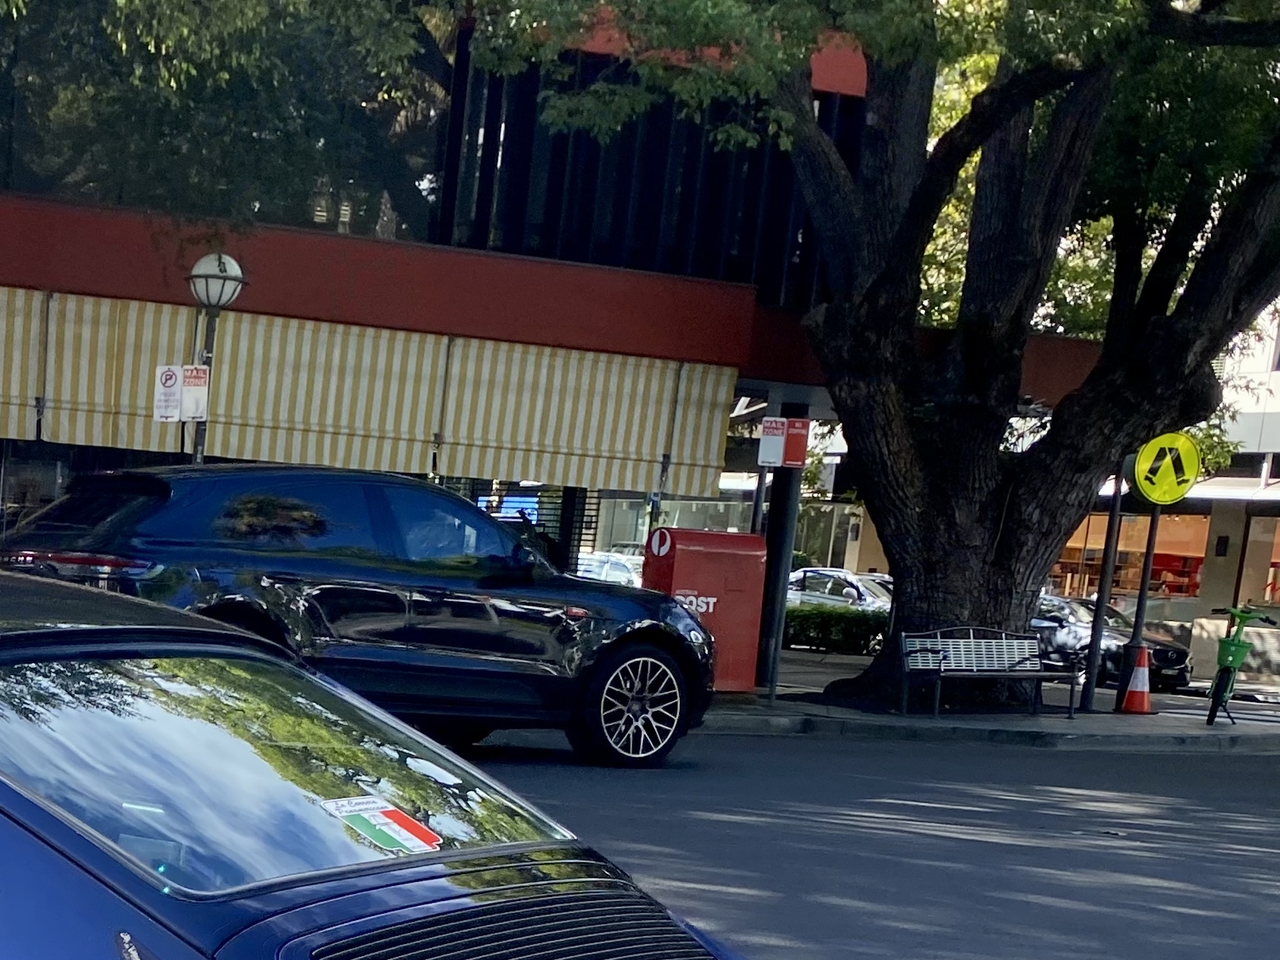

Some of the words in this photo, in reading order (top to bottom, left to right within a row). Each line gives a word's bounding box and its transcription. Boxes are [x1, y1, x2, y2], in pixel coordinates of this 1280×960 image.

[184, 370, 206, 378] MAIL
[184, 378, 206, 386] ZONE
[764, 421, 784, 429] MAIL
[763, 428, 784, 436] ZONE
